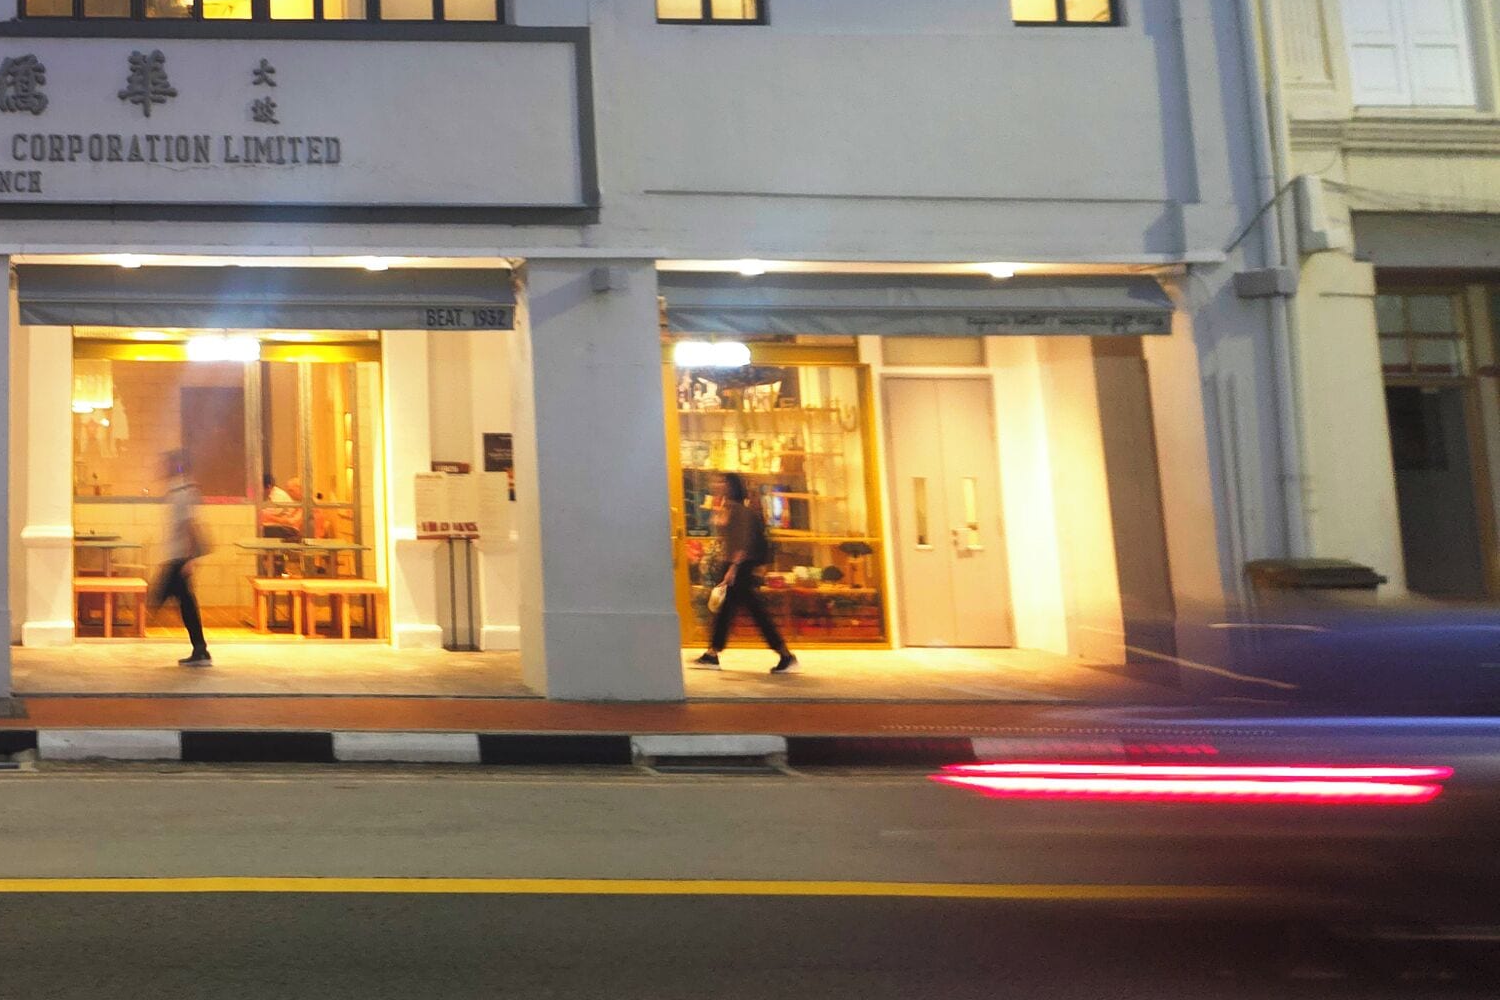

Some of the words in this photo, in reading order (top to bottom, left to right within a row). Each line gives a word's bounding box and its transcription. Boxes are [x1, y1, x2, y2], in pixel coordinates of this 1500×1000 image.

[11, 133, 211, 164] CORPORATION
[224, 135, 342, 165] LIMITED
[473, 309, 507, 327] 1932
